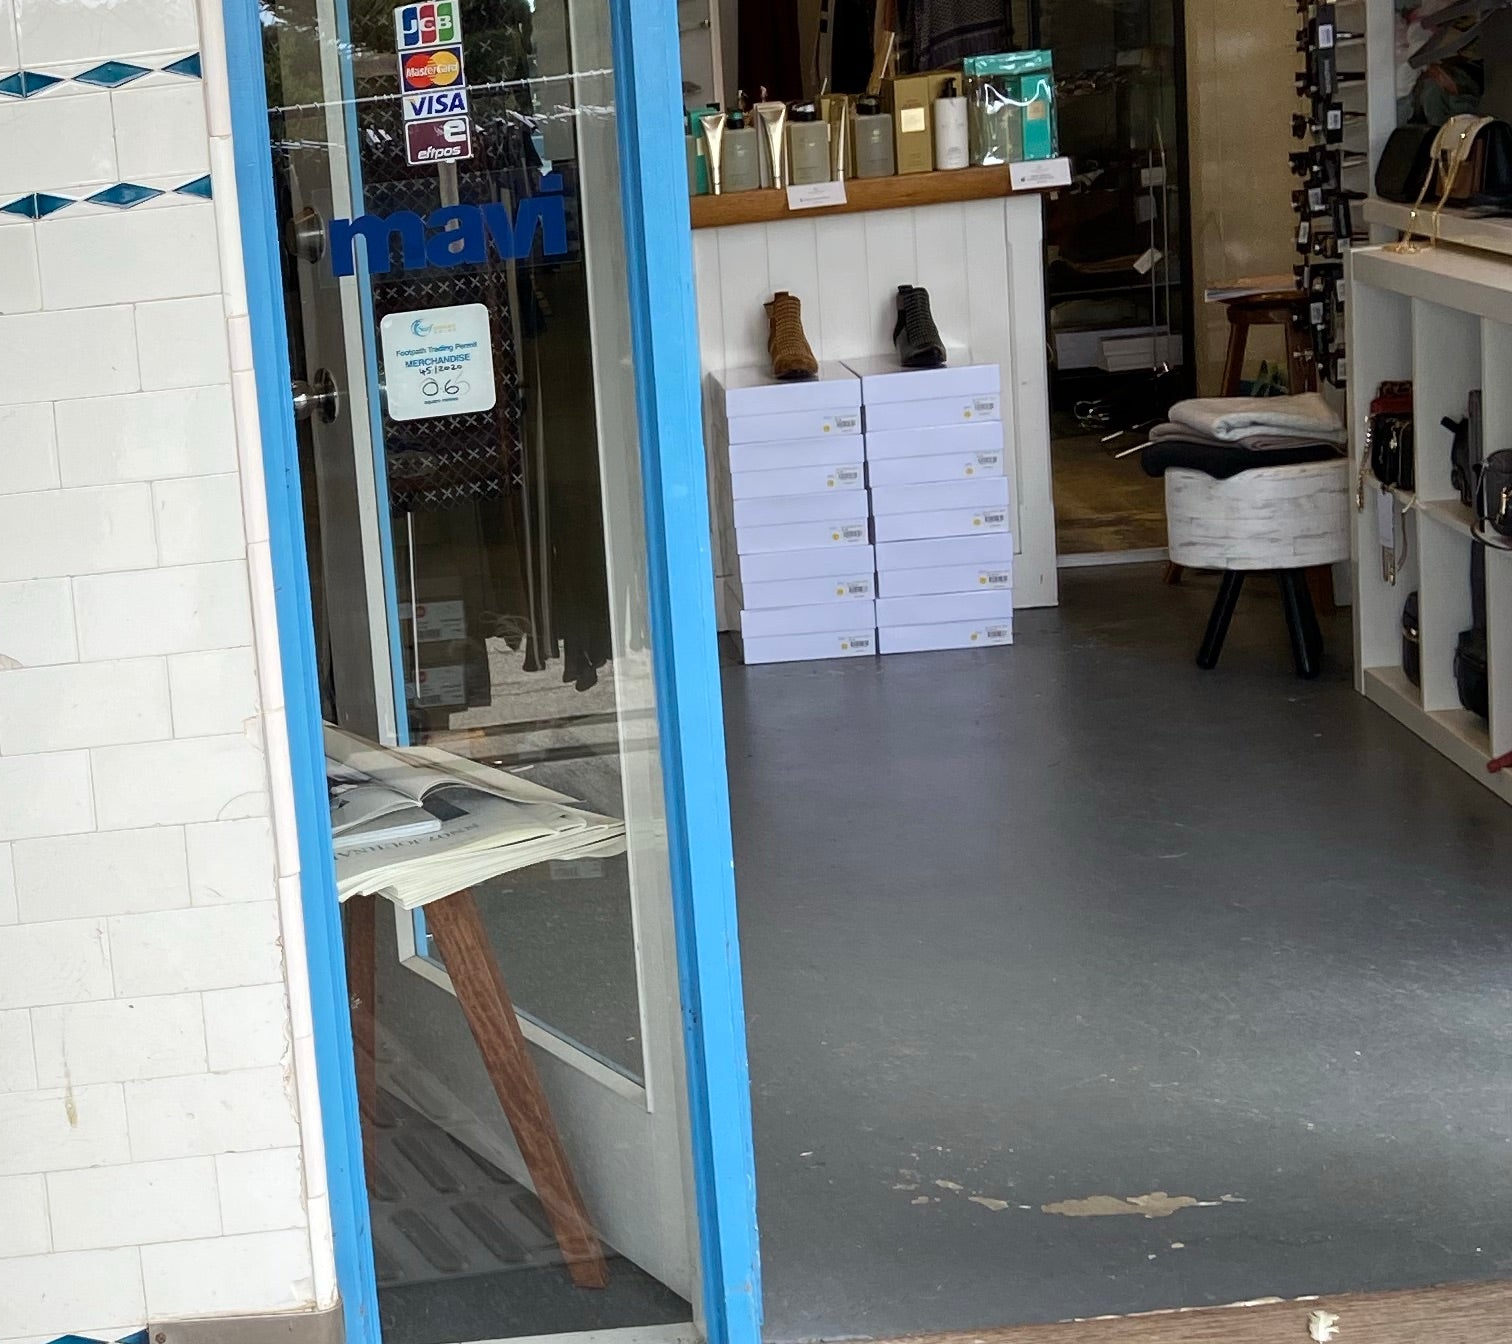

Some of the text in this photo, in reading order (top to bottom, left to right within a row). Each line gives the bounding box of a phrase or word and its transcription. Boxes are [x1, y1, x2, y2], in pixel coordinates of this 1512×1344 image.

[406, 92, 465, 116] VISA
[417, 145, 461, 159] eftpos
[329, 173, 568, 277] mavi
[396, 341, 477, 357] Footpath Trading Permit
[405, 353, 470, 368] MERCHANDISE
